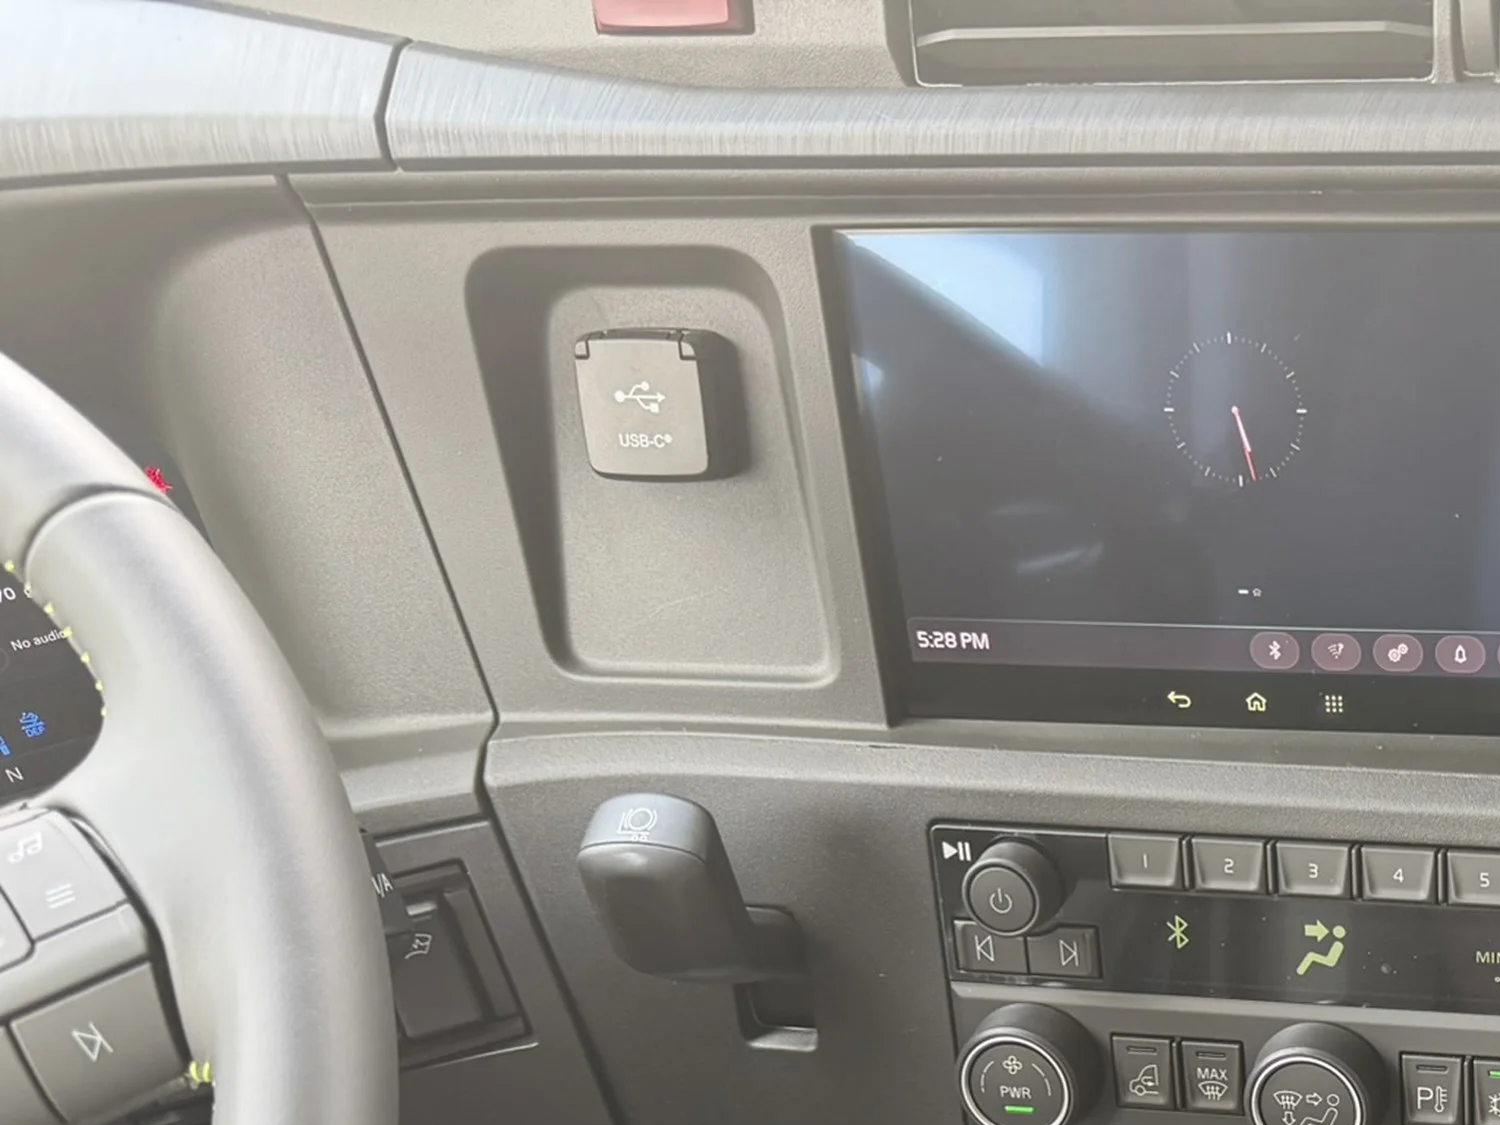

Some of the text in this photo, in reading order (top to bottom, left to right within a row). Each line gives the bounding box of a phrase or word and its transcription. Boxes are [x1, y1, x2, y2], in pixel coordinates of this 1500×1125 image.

[10, 629, 68, 651] No audio
[916, 630, 990, 650] 5:28 PM
[5, 766, 24, 783] N
[1142, 853, 1149, 869] 1
[1224, 858, 1234, 874] 2
[1308, 862, 1319, 879] 3
[1393, 868, 1404, 883] 4
[1479, 872, 1490, 888] 5
[1196, 1067, 1228, 1081] MAX
[999, 1085, 1032, 1099] PWR
[1416, 1088, 1434, 1110] P
